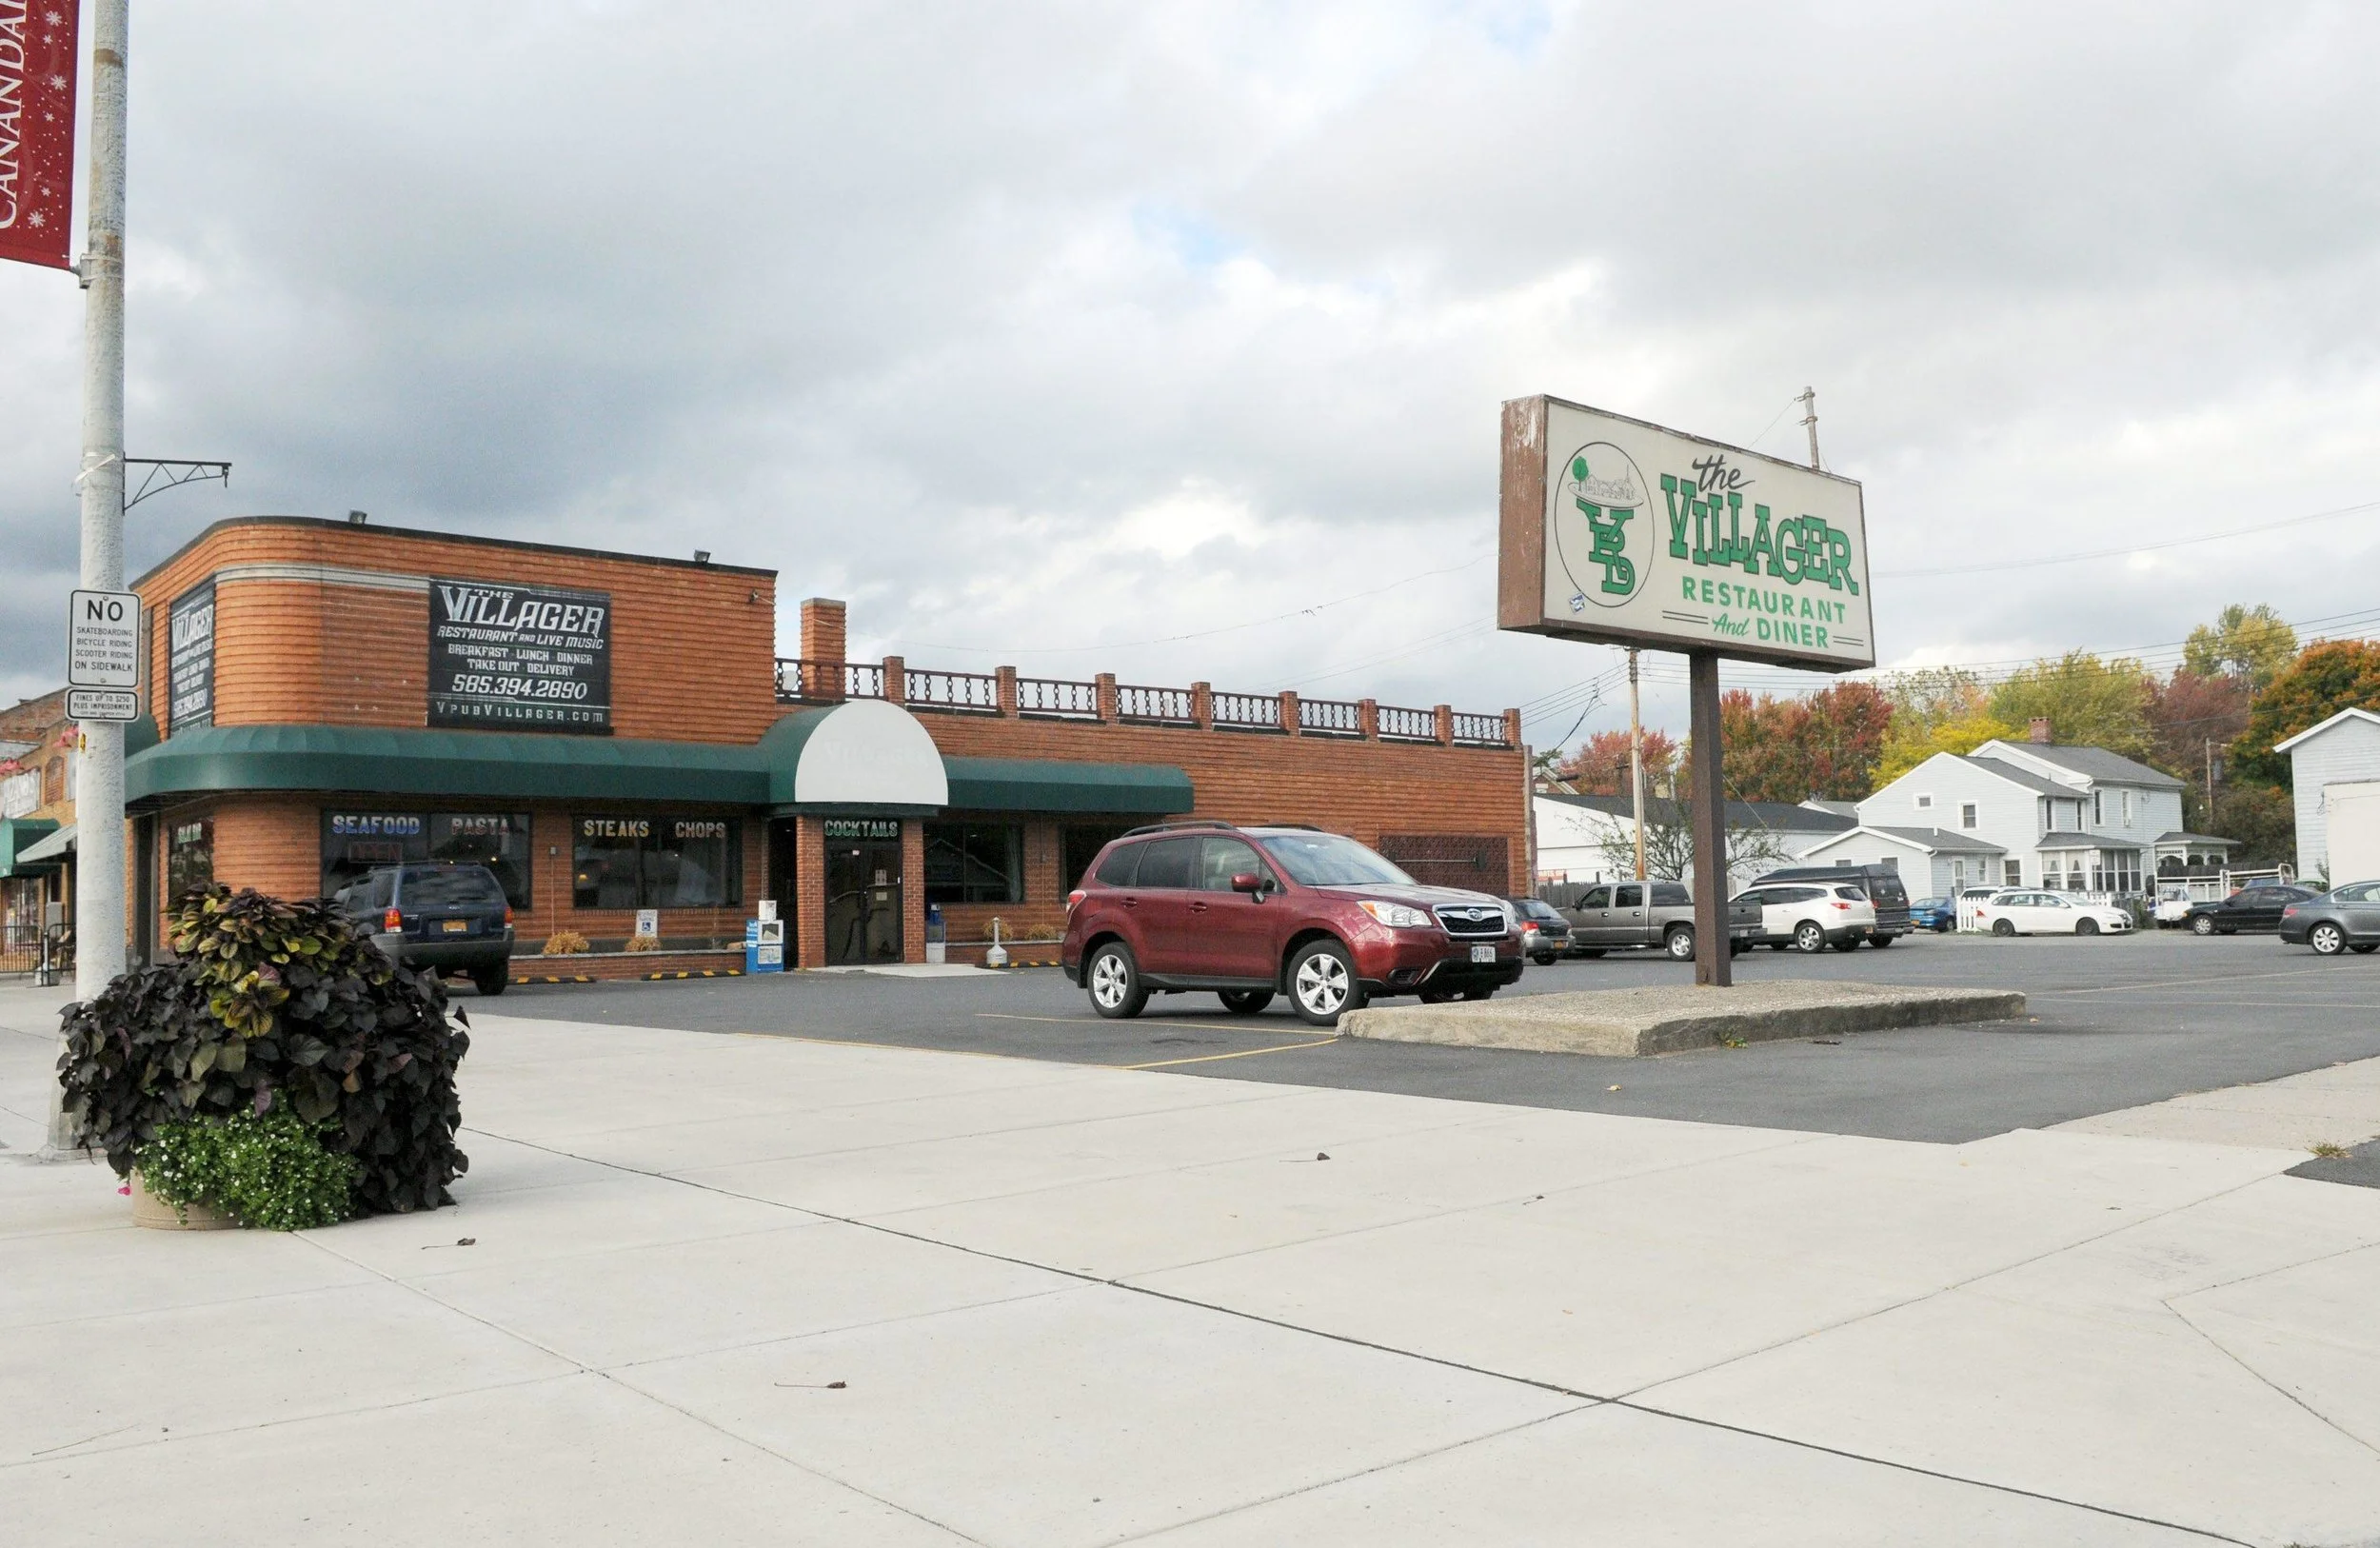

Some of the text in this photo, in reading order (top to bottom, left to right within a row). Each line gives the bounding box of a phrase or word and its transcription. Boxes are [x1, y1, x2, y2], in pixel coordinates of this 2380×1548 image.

[1692, 454, 1755, 491] the
[1660, 472, 1859, 596] VILLAGER
[473, 588, 515, 600] THE
[1682, 576, 1846, 625] RESTAURANT
[87, 600, 124, 622] NO
[437, 585, 605, 639] VILLAGER
[76, 626, 133, 637] SKATEBOARDING
[437, 625, 605, 649] RESTAURANT AND LIVE MUSIC
[1712, 612, 1829, 648] And DINER
[76, 638, 132, 648] BICYCLE RIDING
[75, 649, 133, 660] SCOOTER RIDING
[447, 644, 593, 665] BREAKFAST LUNCH DINNER
[75, 661, 133, 672] ON SIDEWALK
[467, 659, 575, 676] TAKE OUT DELIVERY
[451, 674, 588, 700] 585.394.2890
[90, 703, 132, 711] IMPRISONMENT
[332, 815, 510, 836] SEAFOOD PASTA
[584, 820, 726, 839] STEAKS CHOPS
[824, 820, 898, 838] COCKTAILS
